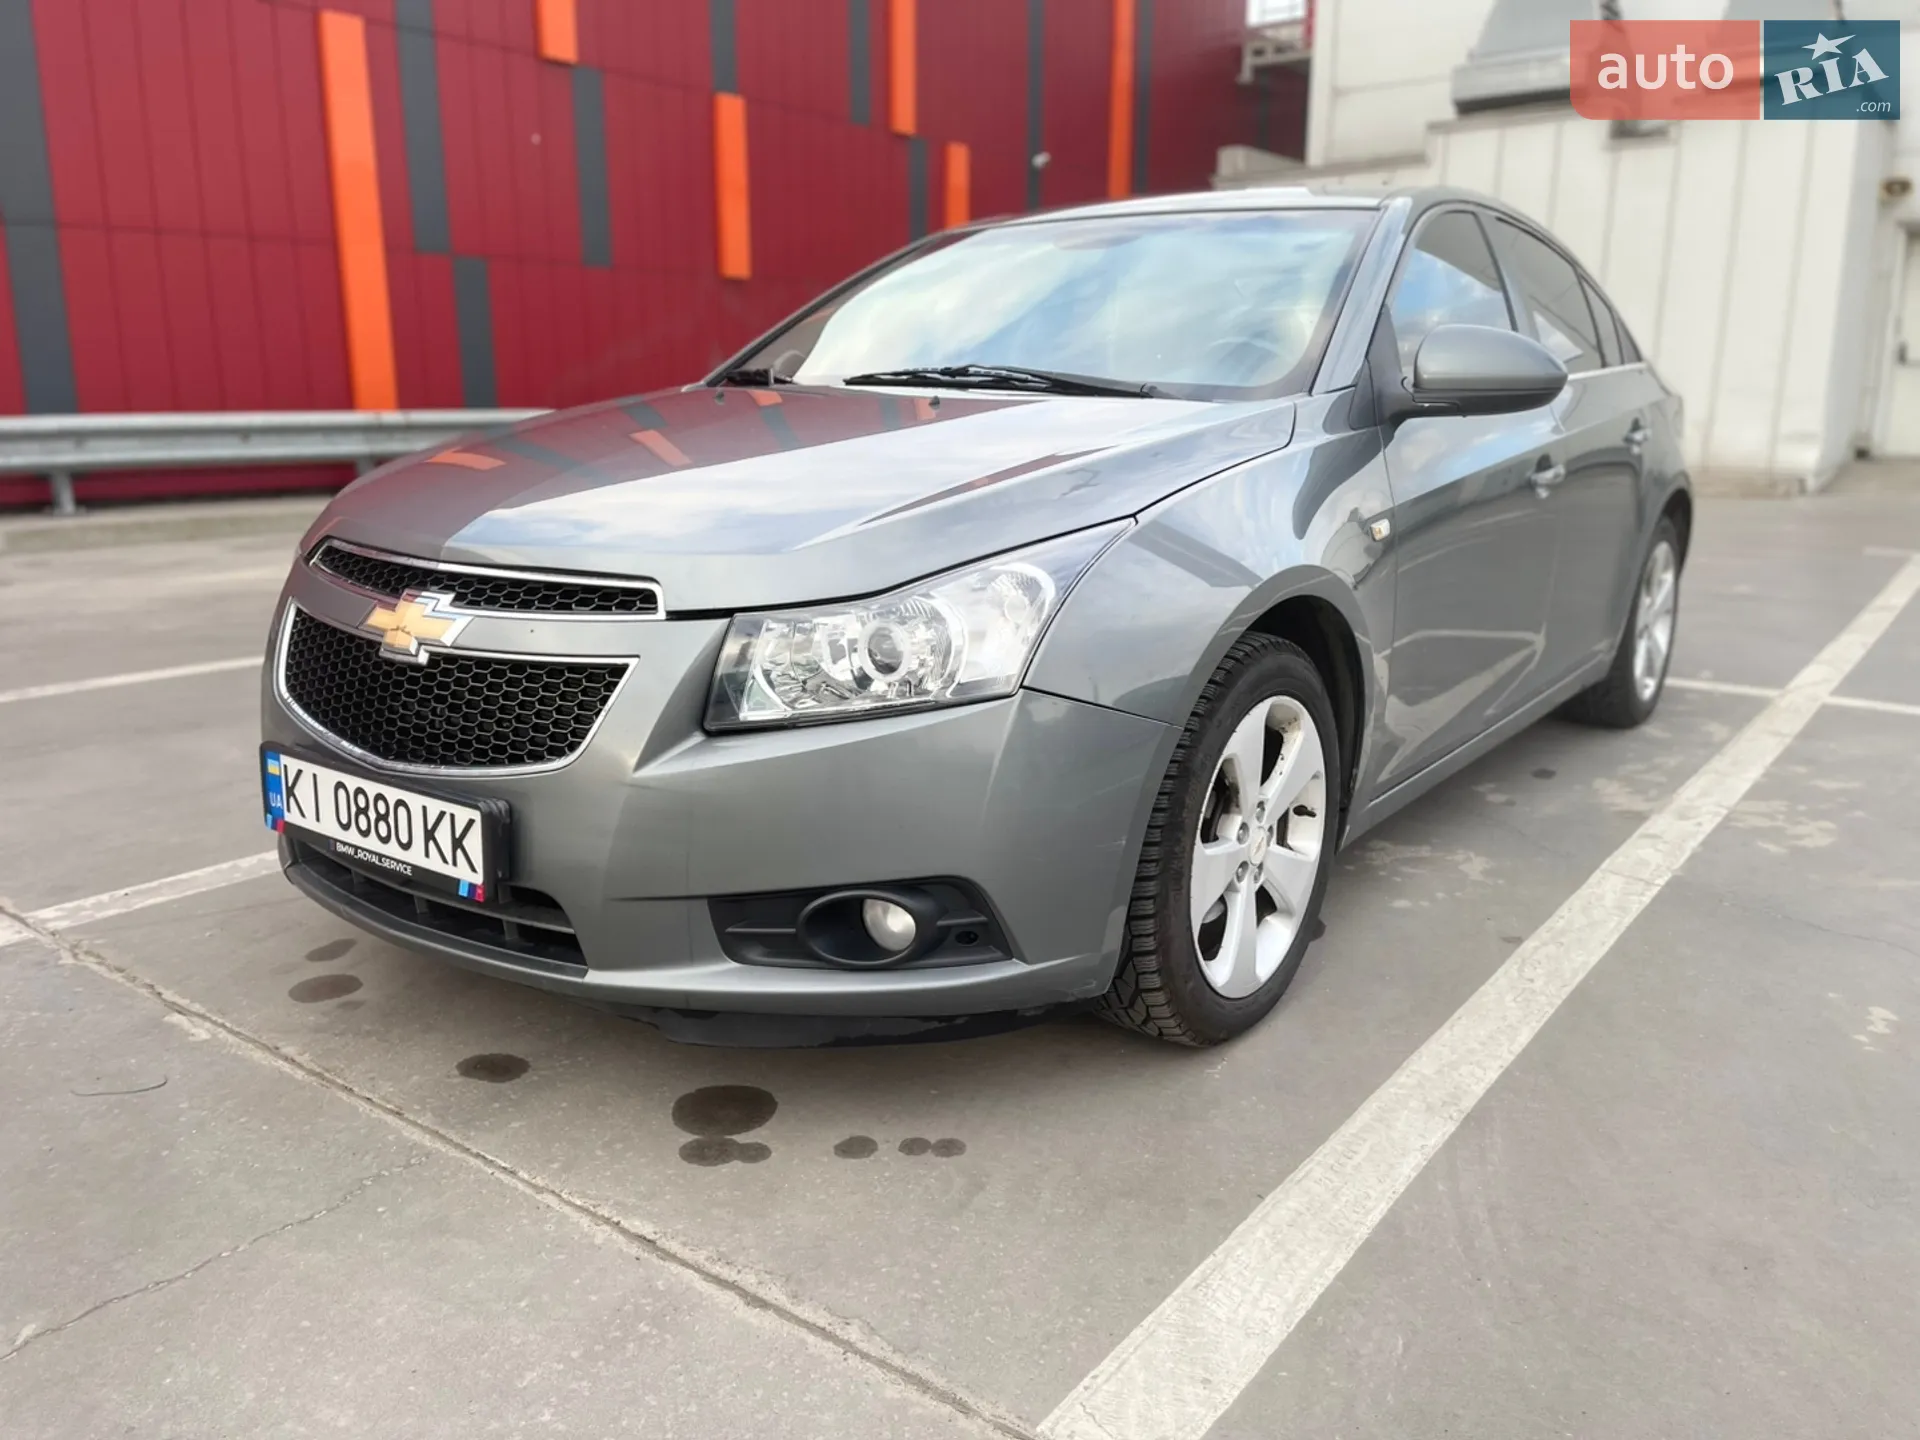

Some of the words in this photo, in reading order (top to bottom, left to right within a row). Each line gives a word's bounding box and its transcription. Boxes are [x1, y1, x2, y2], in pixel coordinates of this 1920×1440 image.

[269, 791, 283, 809] UA
[283, 764, 321, 823] KI
[333, 780, 413, 851] 0880
[422, 805, 478, 874] KK
